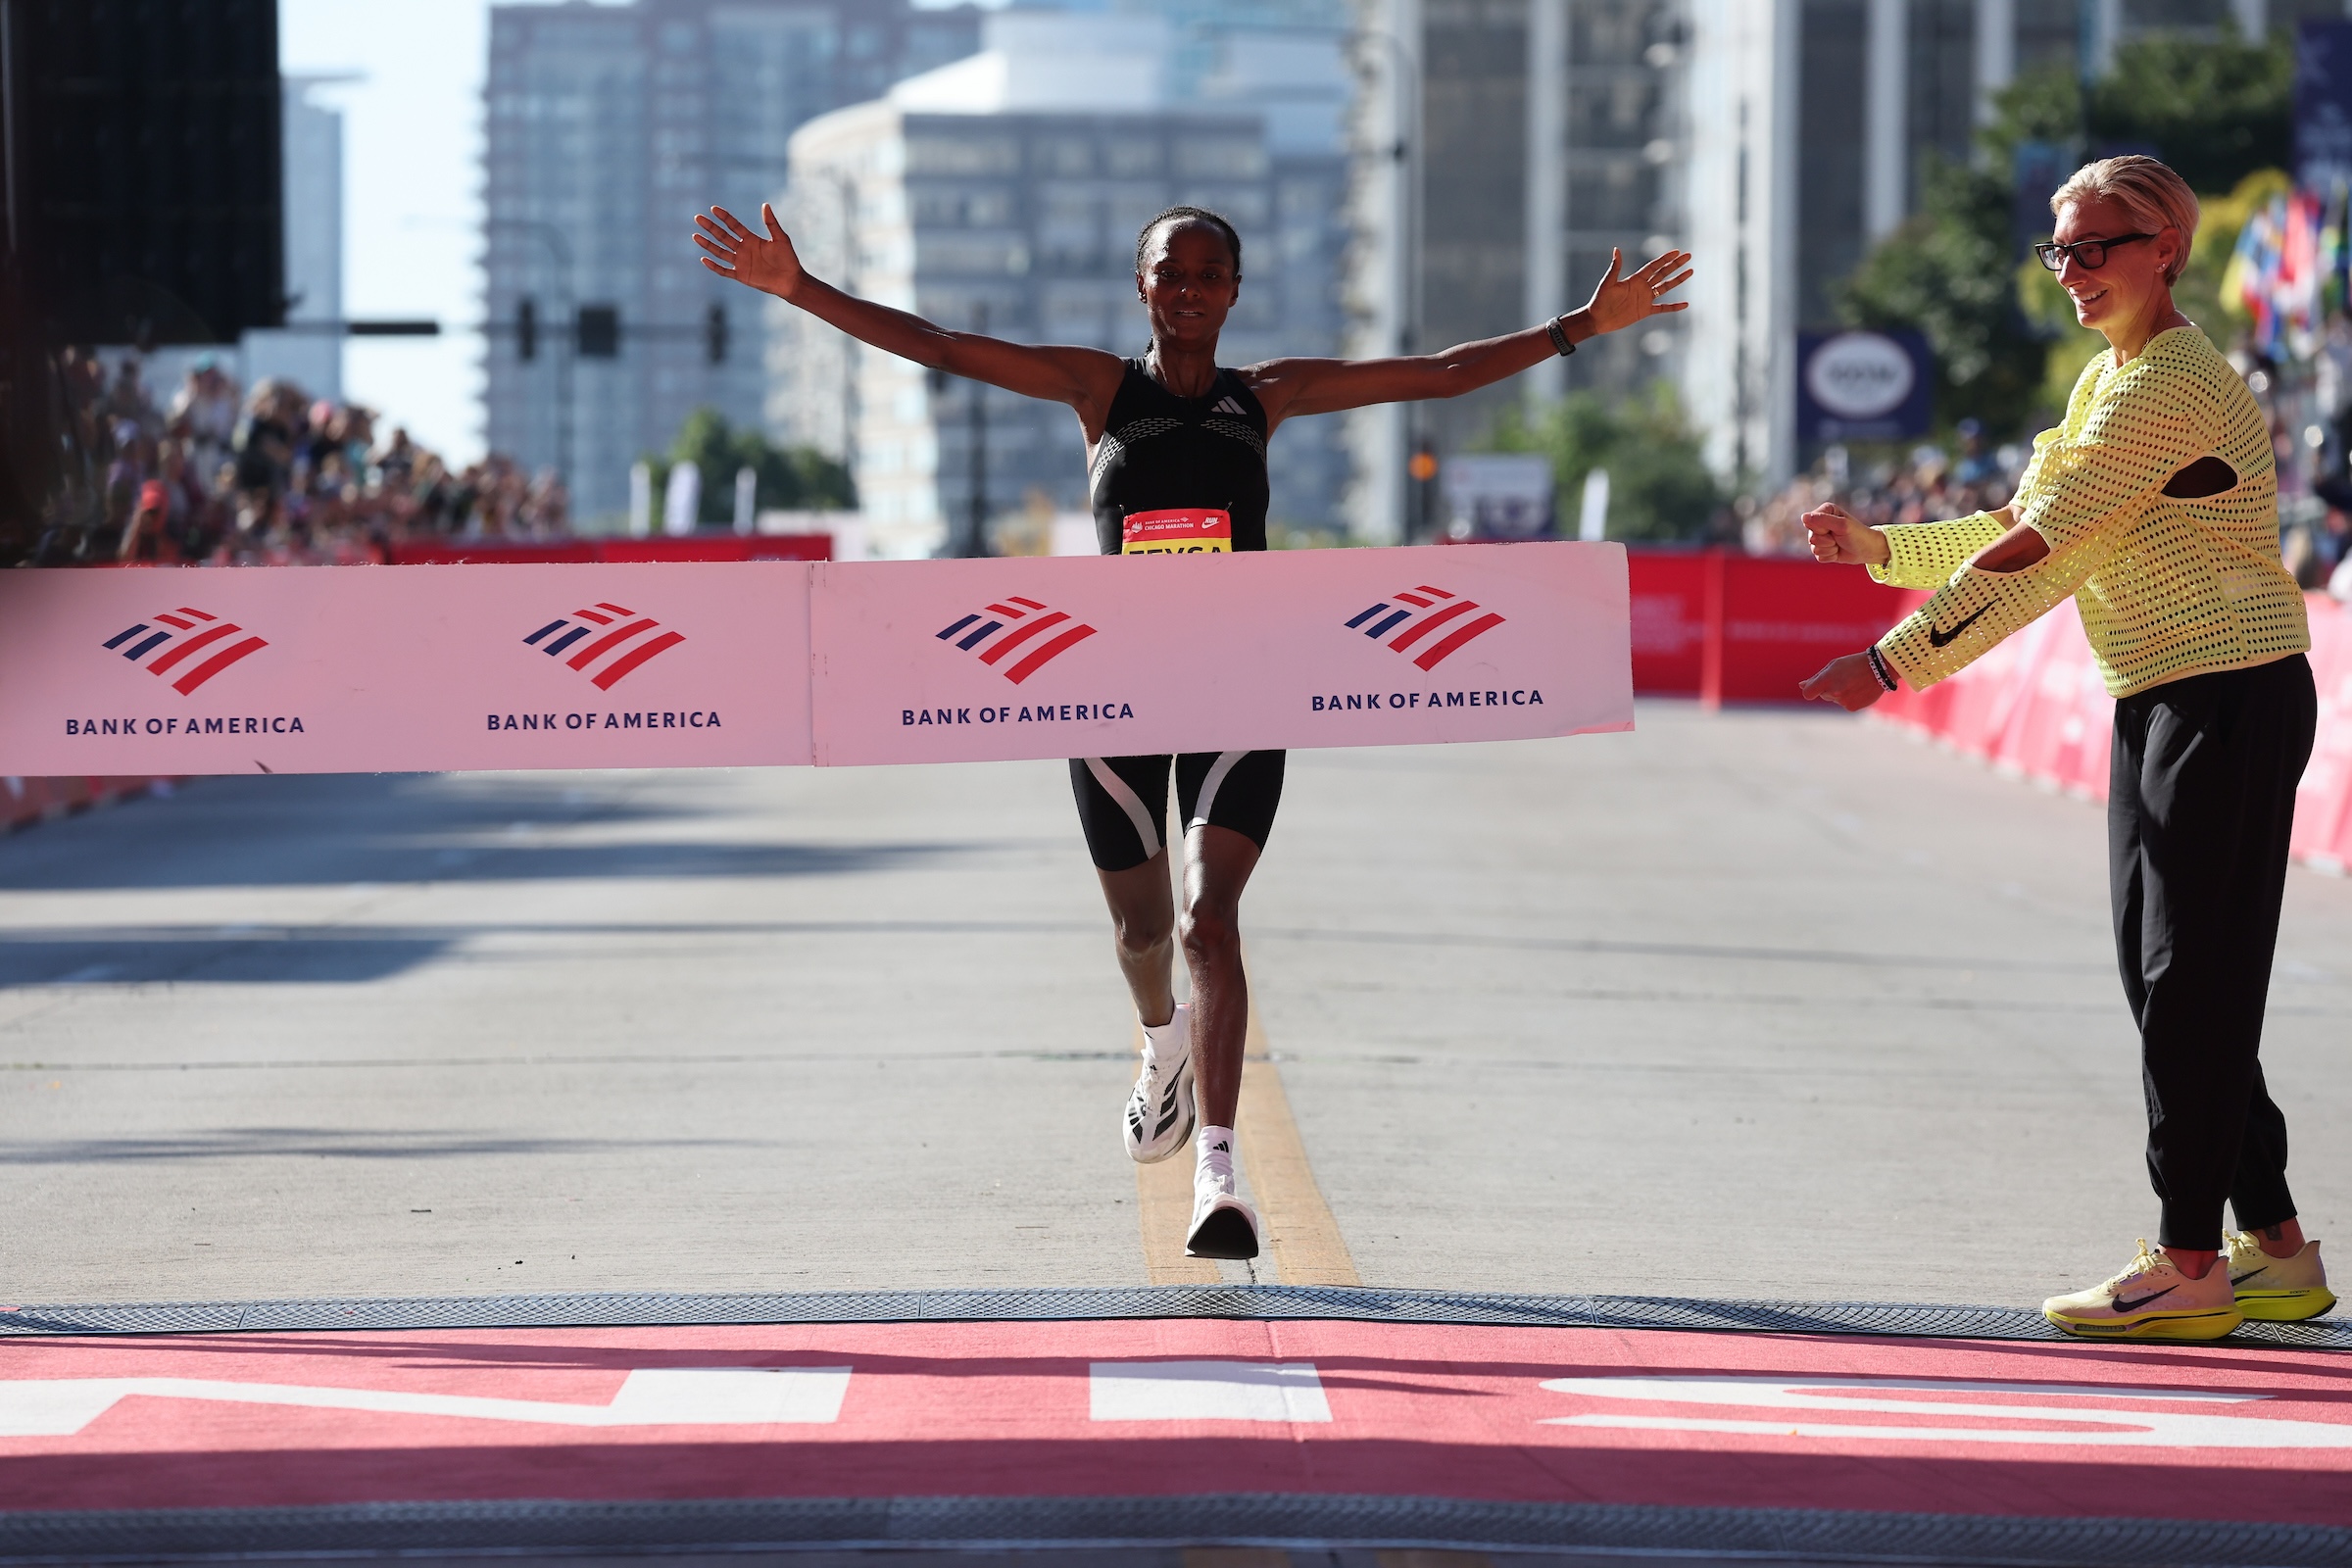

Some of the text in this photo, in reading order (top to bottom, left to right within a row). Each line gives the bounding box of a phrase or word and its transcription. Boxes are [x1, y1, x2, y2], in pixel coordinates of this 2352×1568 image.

[1311, 689, 1544, 711] BANK OF AMERICA
[487, 711, 721, 731] BANK OF AMERICA
[902, 703, 1134, 726] BANK OF AMERICA
[66, 716, 305, 735] BANK OF AMERICA
